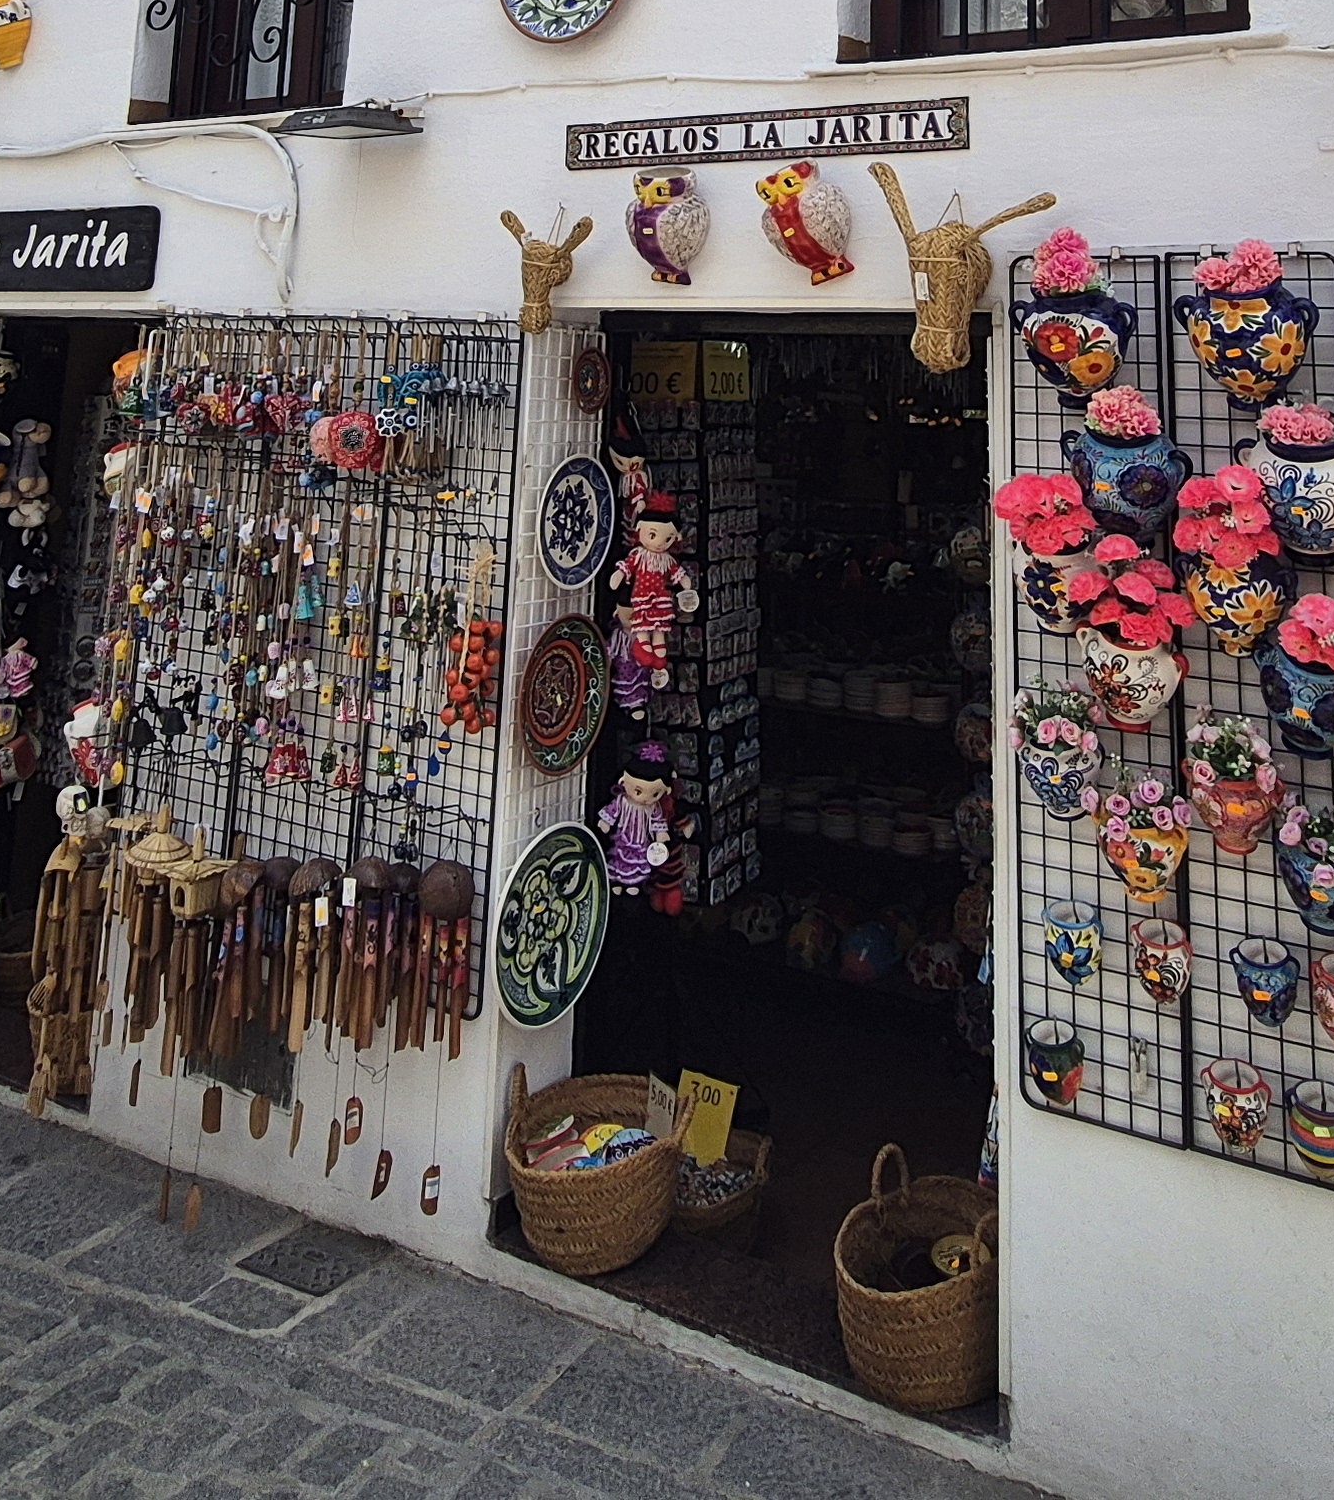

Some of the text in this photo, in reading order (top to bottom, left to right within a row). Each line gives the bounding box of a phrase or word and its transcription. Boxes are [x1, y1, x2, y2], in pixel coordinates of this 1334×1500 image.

[584, 111, 945, 159] REGALOS LA JARITA
[12, 219, 129, 269] Jarita
[630, 371, 659, 395] 00
[710, 371, 736, 398] 2,00
